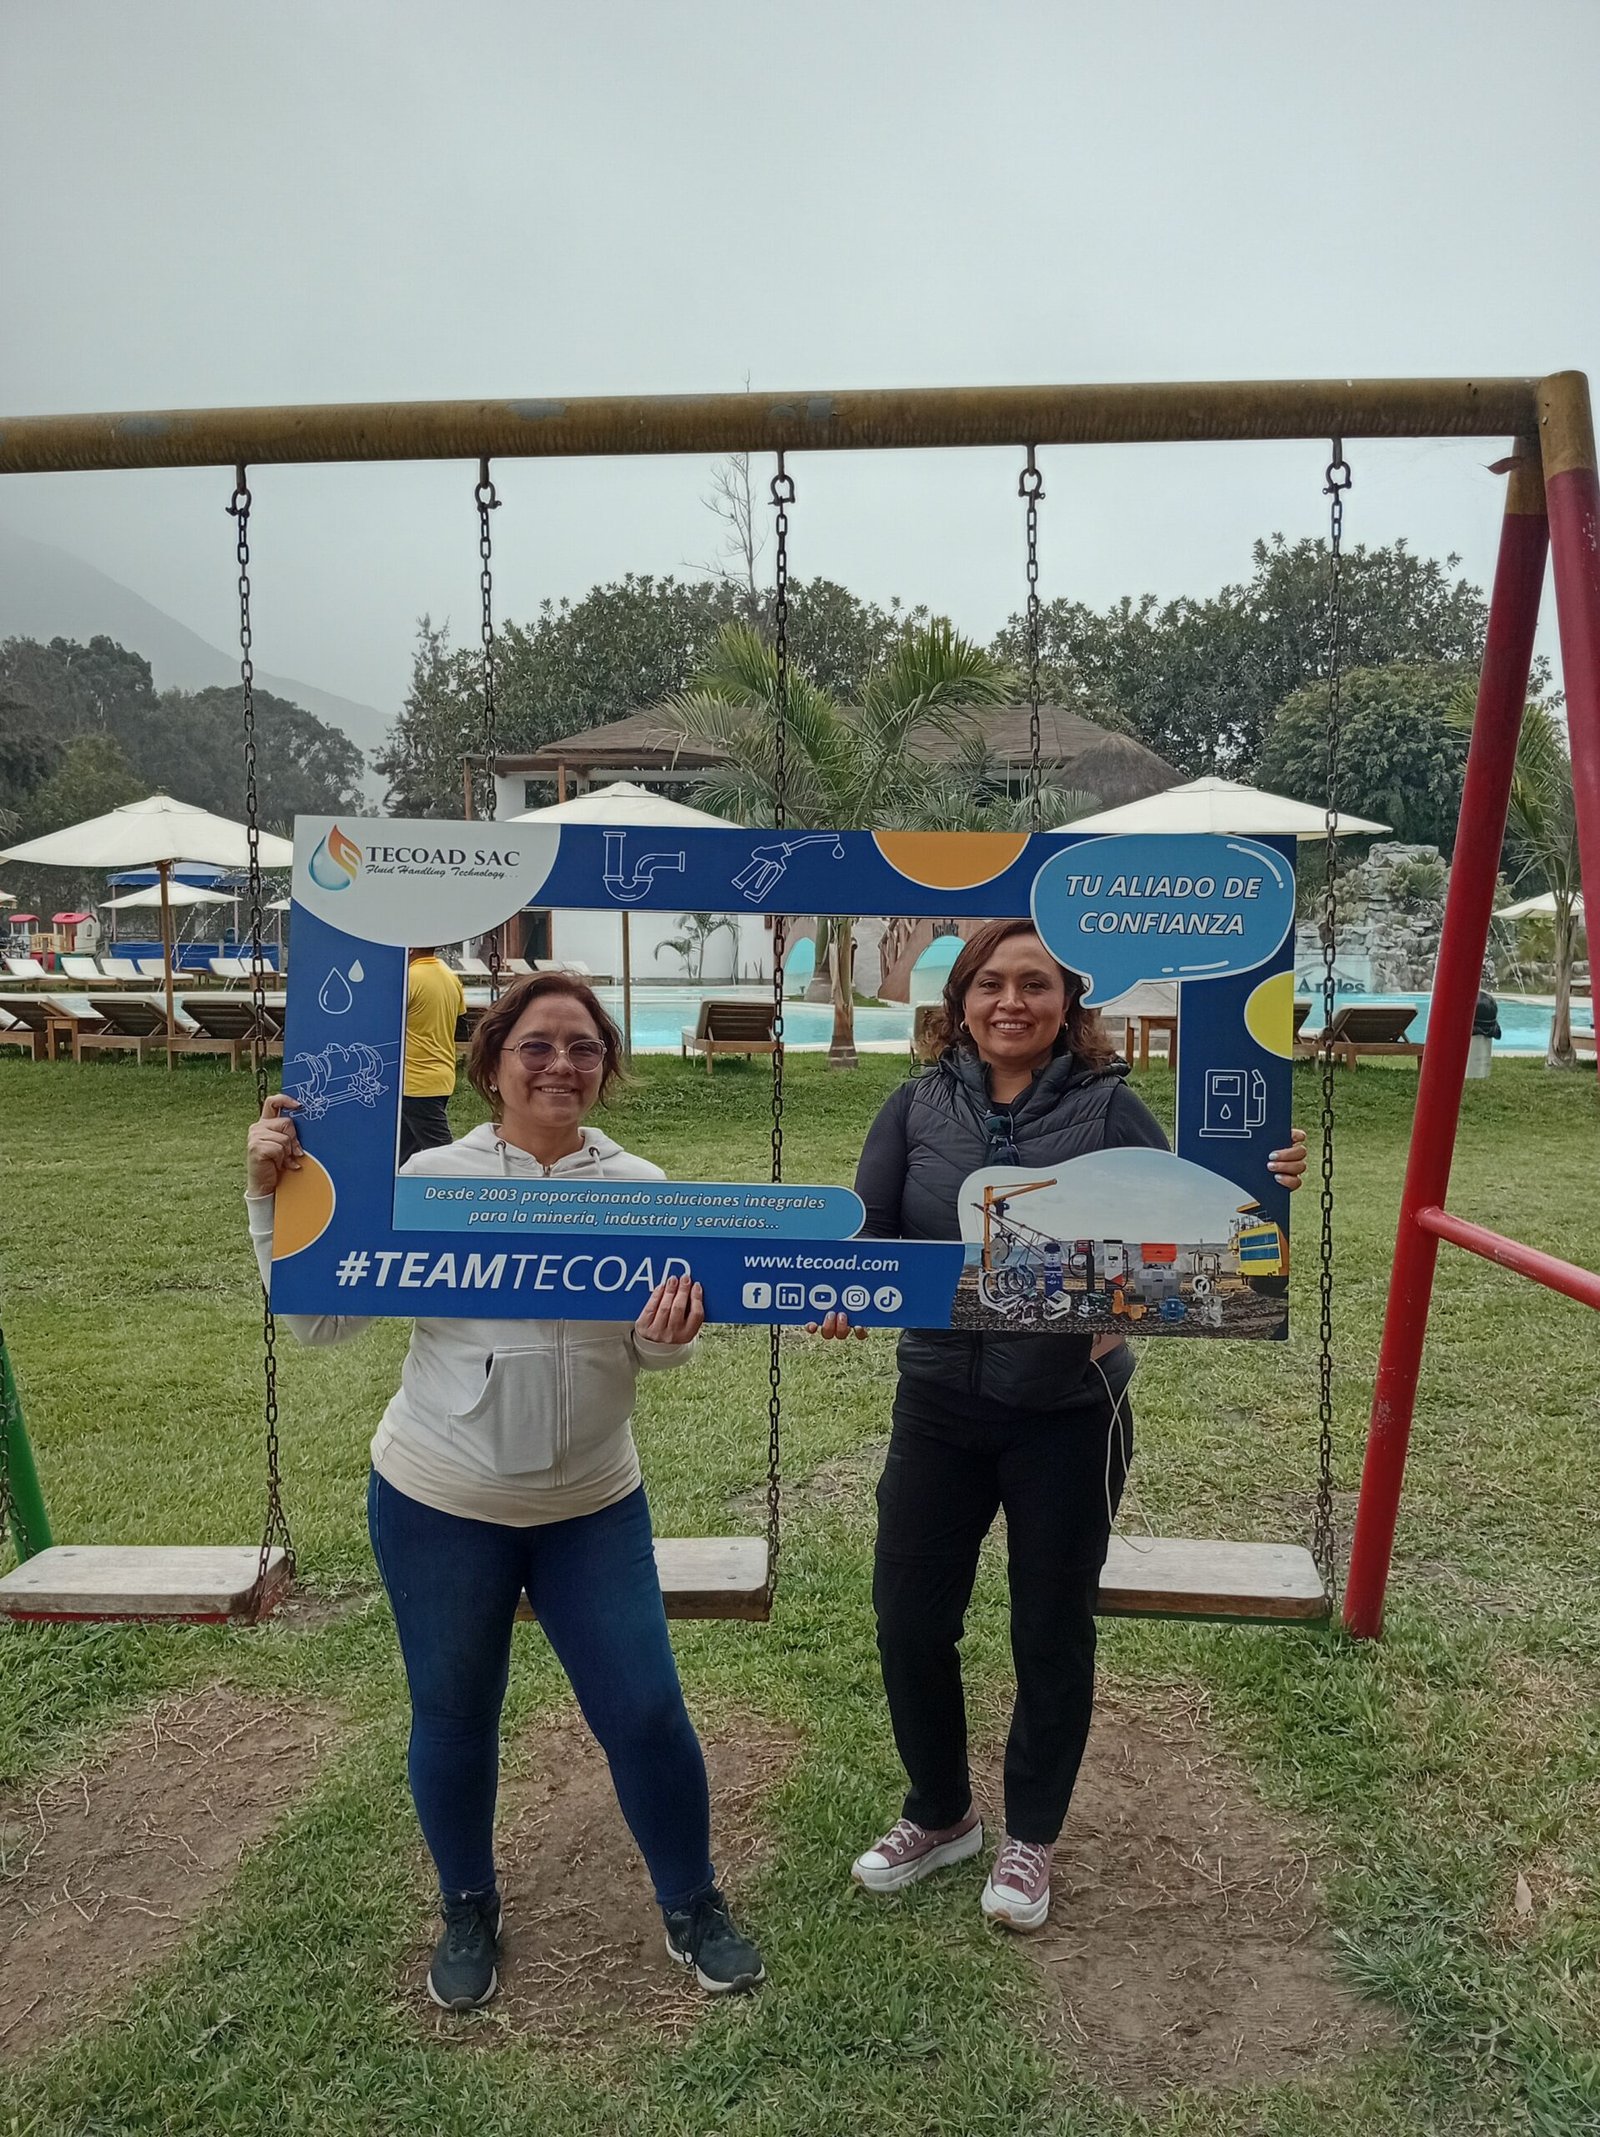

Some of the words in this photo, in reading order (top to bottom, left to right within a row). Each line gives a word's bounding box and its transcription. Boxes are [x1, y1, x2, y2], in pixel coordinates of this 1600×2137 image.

[365, 846, 467, 865] TECOAD
[473, 850, 520, 867] SAC
[365, 864, 396, 875] Fluid
[397, 865, 446, 878] Handling
[1066, 875, 1104, 897] TU
[1107, 875, 1216, 898] ALIADO
[1222, 877, 1263, 899] DE
[1079, 911, 1245, 936] CONFIANZA
[425, 1187, 475, 1201] Desde
[478, 1188, 518, 1202] 2003
[520, 1190, 651, 1206] proporcionando
[655, 1192, 740, 1207] soluciones
[743, 1194, 826, 1212] integrales
[468, 1209, 508, 1225] para
[511, 1210, 528, 1223] la
[531, 1210, 599, 1226] minería,
[604, 1211, 678, 1227] industria
[680, 1216, 693, 1230] y
[695, 1214, 780, 1230] servicios...
[335, 1251, 692, 1292] #TEAMTECOAD
[743, 1254, 900, 1272] www.tecoad.com
